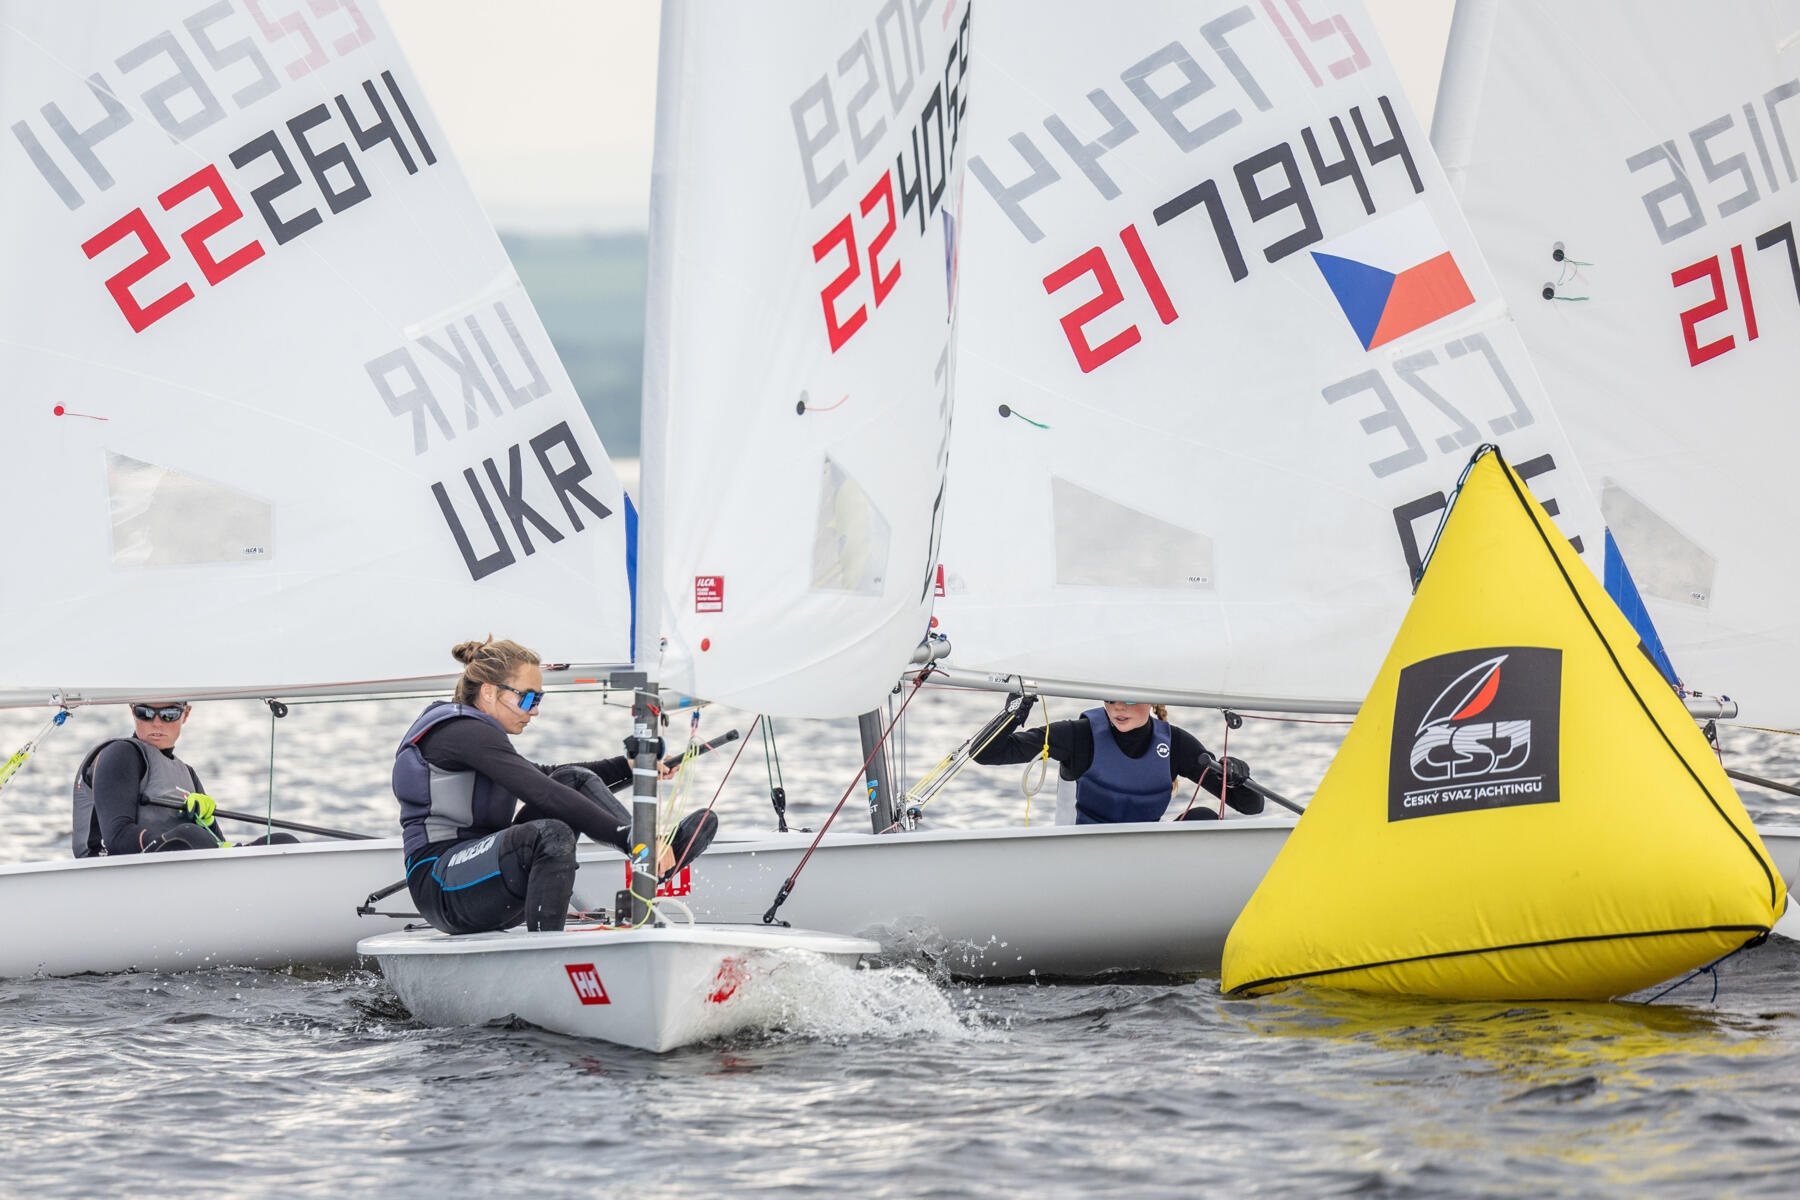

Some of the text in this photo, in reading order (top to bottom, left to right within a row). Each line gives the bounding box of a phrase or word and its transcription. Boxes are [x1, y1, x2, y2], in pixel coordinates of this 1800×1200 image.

[81, 70, 437, 334] 222641
[1042, 95, 1424, 373] 217944
[431, 421, 613, 581] UKR
[1403, 782, 1542, 807] ČESKÝ SVAZ JACHTINGU
